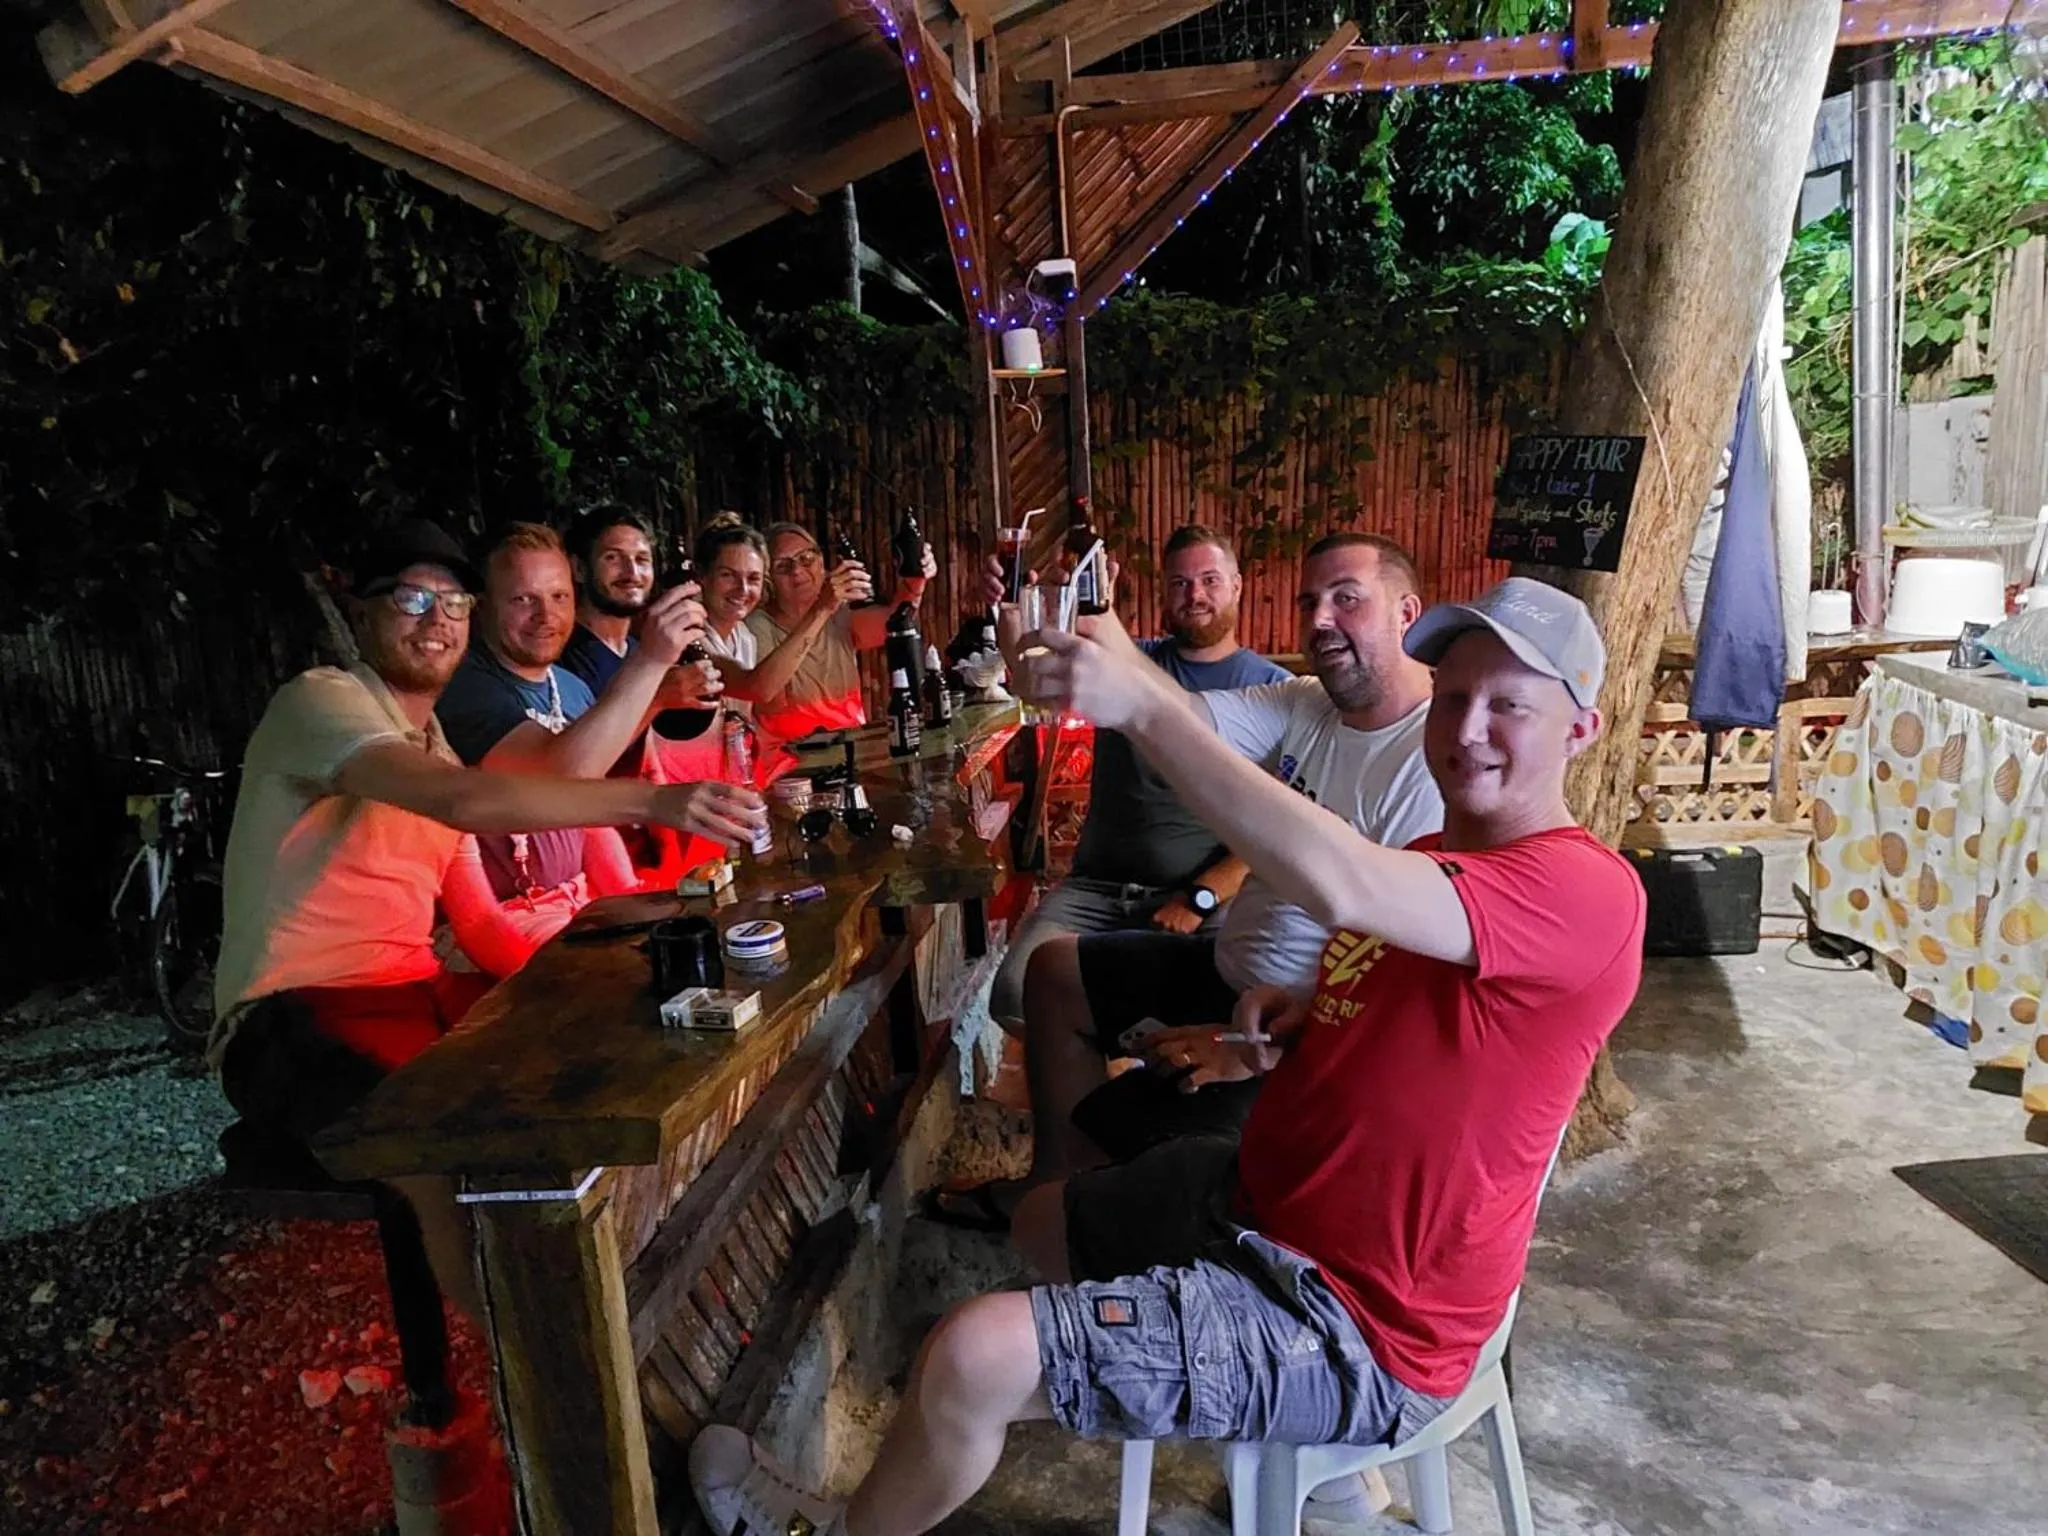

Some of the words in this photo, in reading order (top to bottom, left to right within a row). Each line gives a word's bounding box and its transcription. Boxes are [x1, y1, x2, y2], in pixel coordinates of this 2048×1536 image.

[1511, 438, 1573, 471] APPY
[1573, 438, 1631, 472] HOUR
[1575, 499, 1618, 530] Shots
